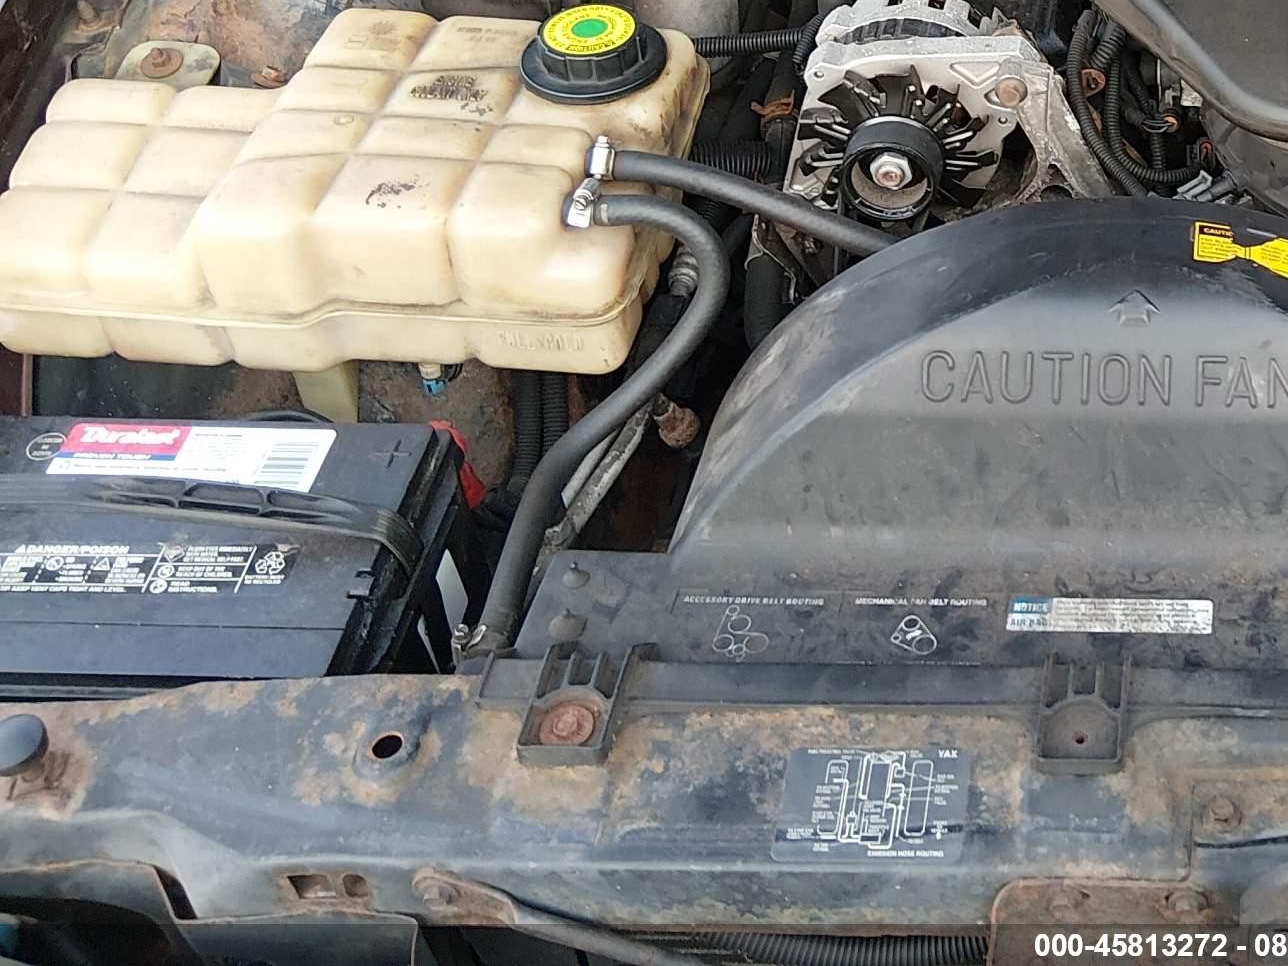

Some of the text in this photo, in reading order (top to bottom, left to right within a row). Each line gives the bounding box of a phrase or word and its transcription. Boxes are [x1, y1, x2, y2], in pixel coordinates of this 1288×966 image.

[920, 349, 1172, 407] CAUTION
[683, 595, 734, 604] ACCESSORY
[734, 596, 760, 604] DRIVE
[786, 597, 825, 605] ROUTING
[855, 597, 908, 605] MECHANICAL
[928, 597, 949, 606] BELT
[949, 598, 987, 606] ROUTING
[1013, 602, 1048, 612] NOTICE
[1010, 618, 1026, 627] AIR
[938, 749, 958, 758] YAX
